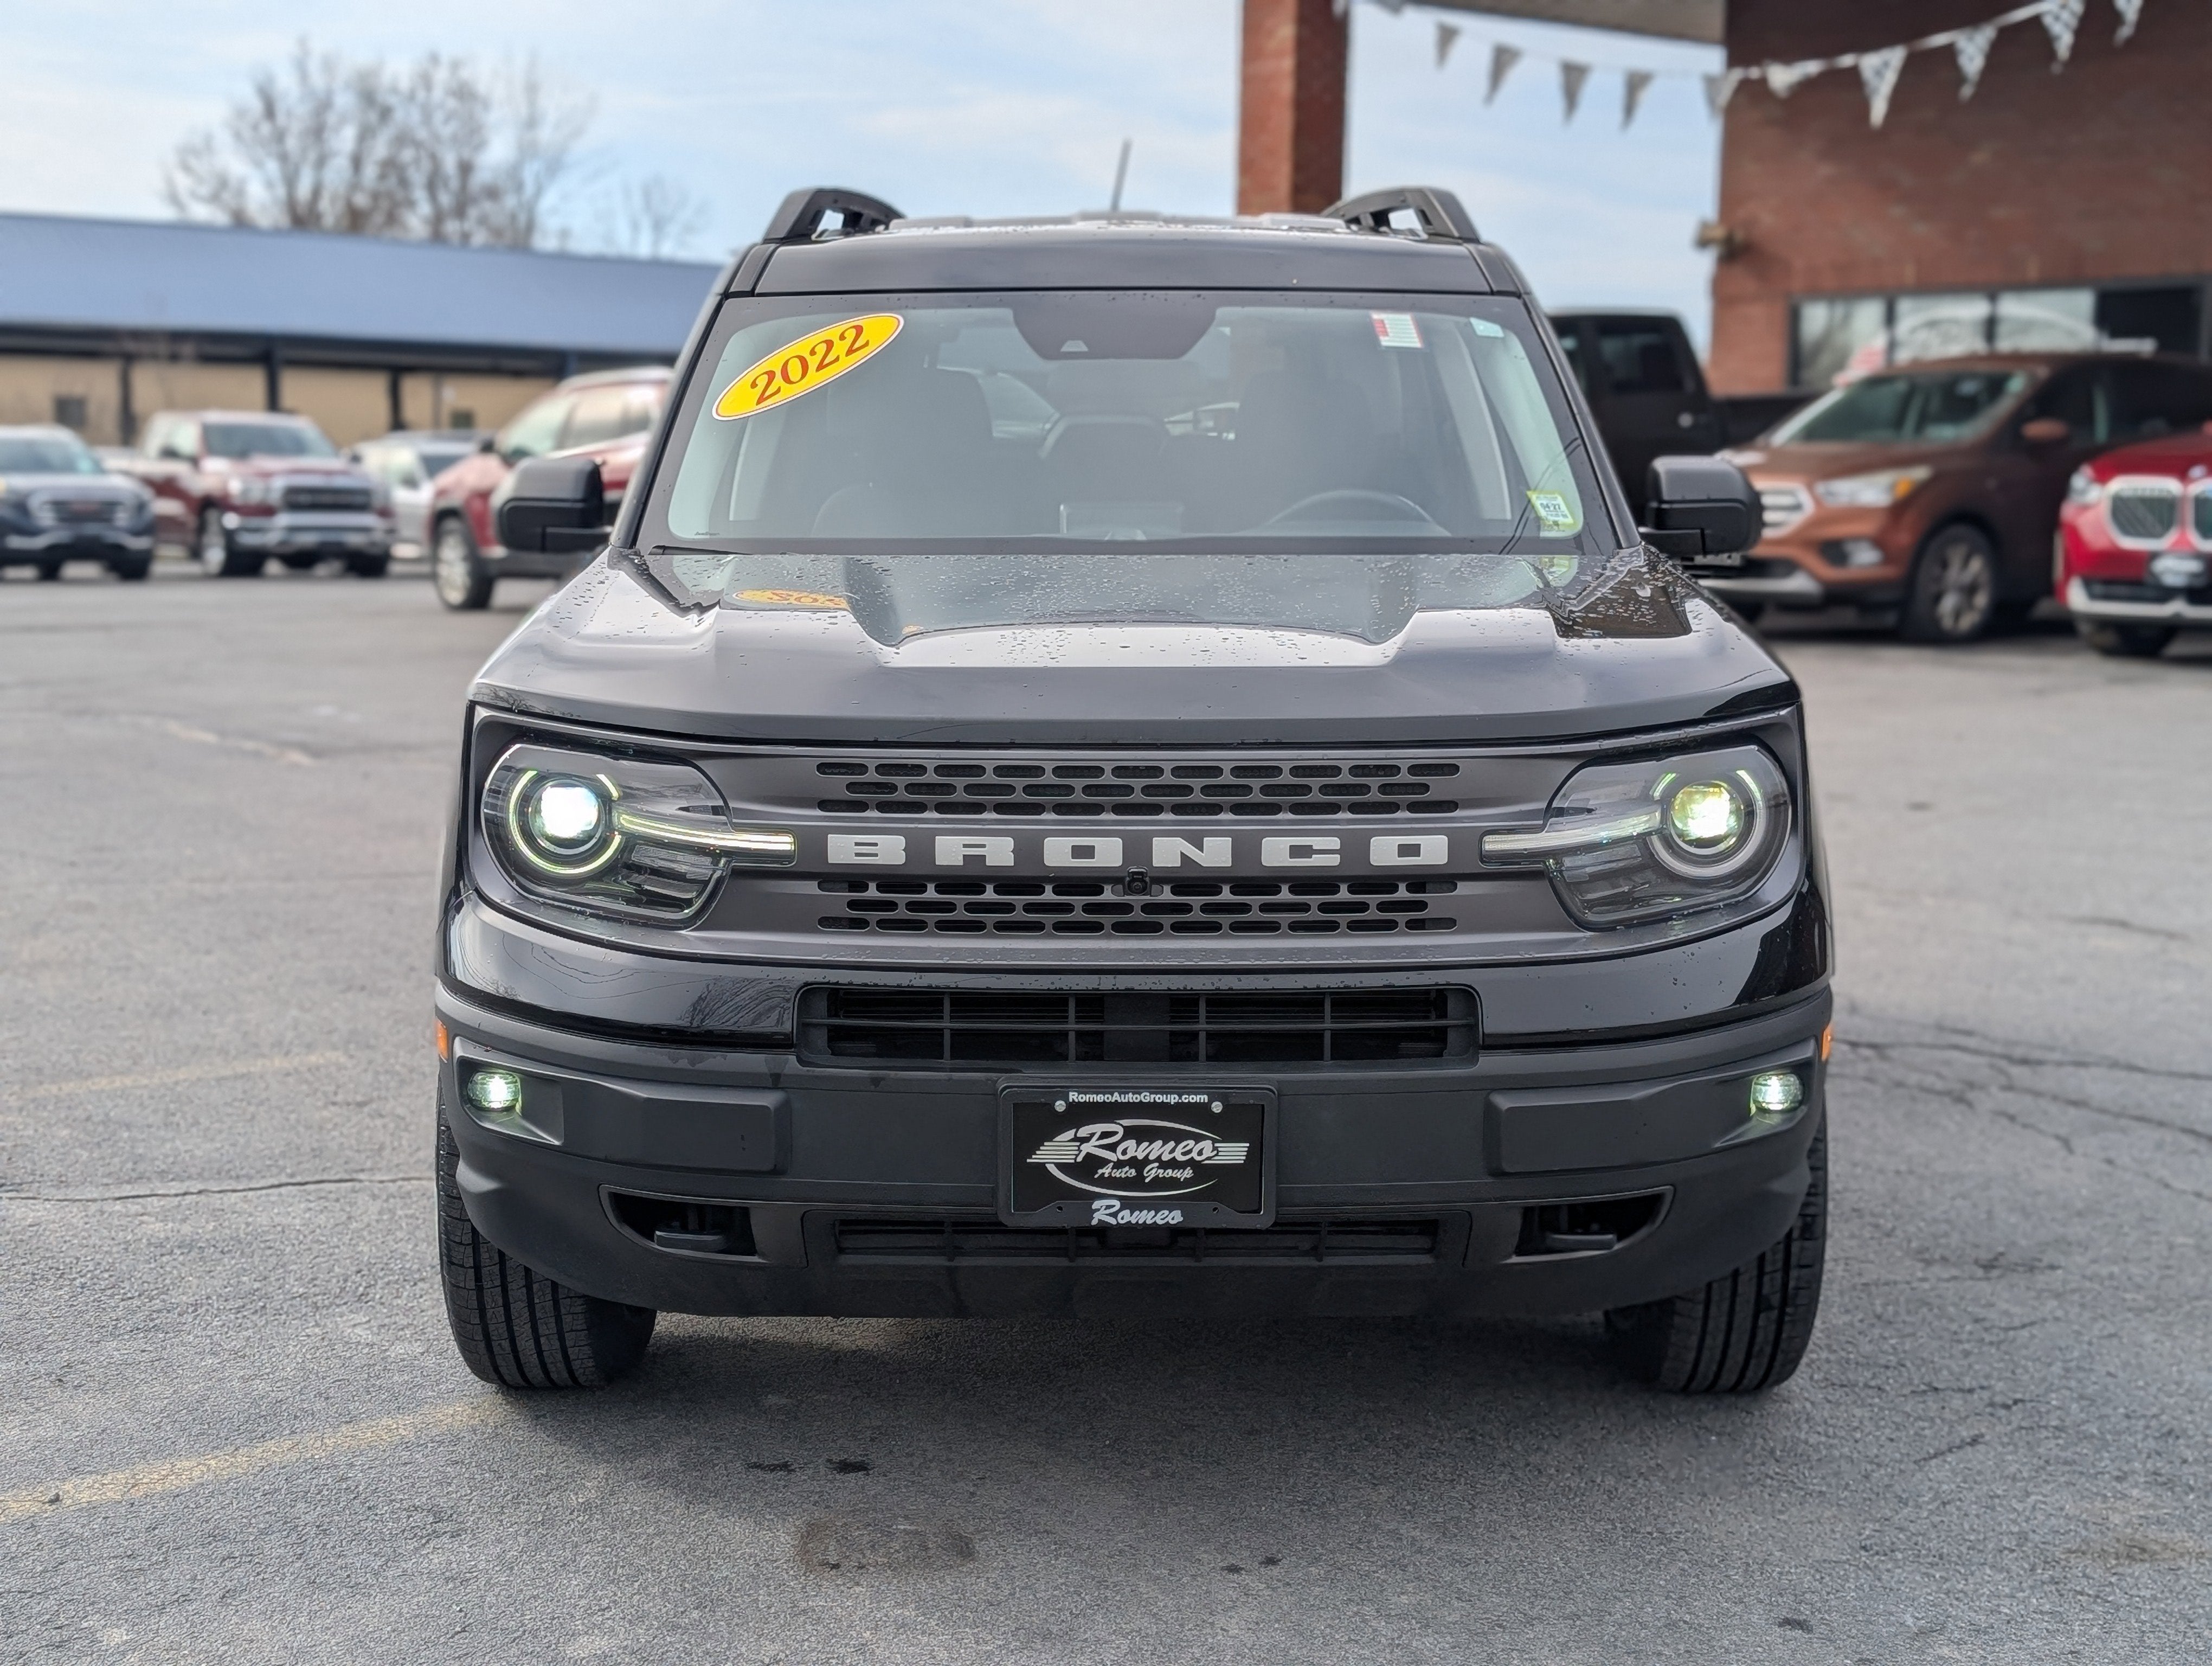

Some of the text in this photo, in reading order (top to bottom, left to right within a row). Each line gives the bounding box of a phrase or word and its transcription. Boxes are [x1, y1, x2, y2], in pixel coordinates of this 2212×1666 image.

[750, 324, 870, 405] 2022
[827, 834, 1449, 867] BRONCO
[1069, 1091, 1208, 1105] RomeoAutoGroup.com
[1076, 1123, 1217, 1162] Romeo
[1094, 1162, 1194, 1183] Auto Group
[1091, 1199, 1184, 1226] Romeo
